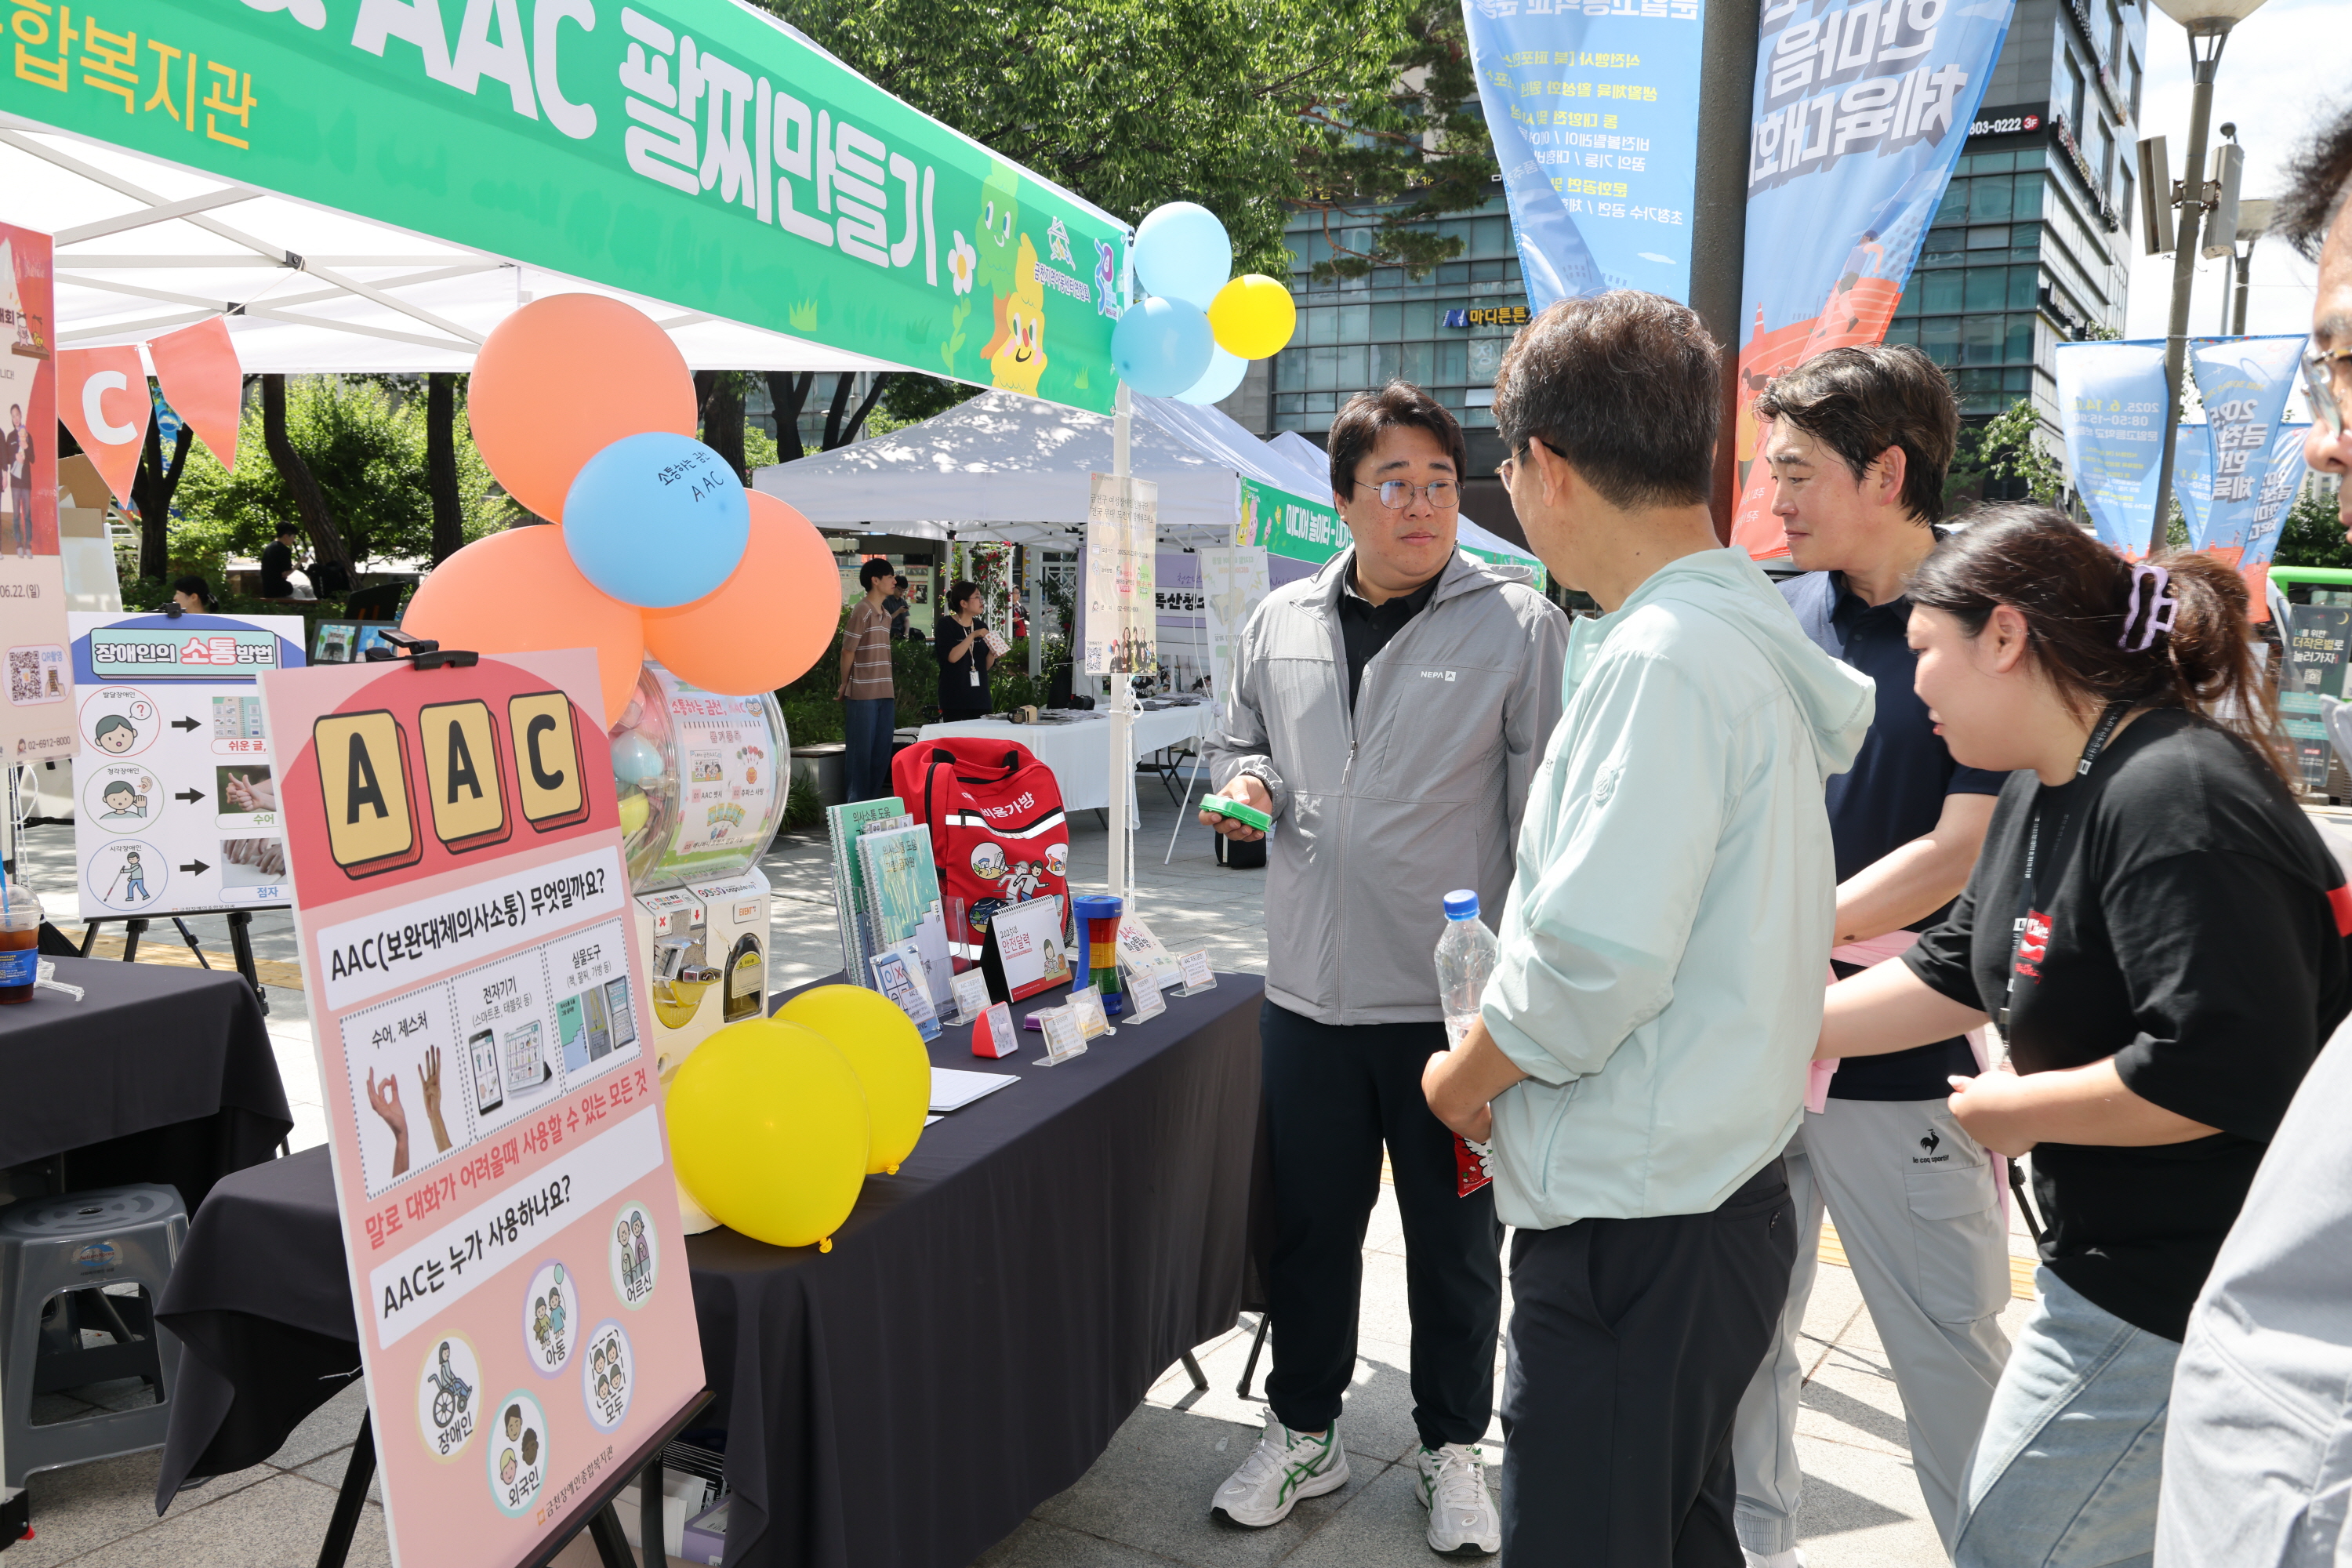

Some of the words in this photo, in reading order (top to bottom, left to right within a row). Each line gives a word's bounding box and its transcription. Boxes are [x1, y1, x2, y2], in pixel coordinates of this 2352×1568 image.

[0, 0, 257, 150] 합복지관
[2024, 118, 2038, 129] 3F
[619, 6, 938, 287] 팔찌만들기
[82, 370, 138, 445] C
[691, 470, 724, 503] AAC
[1286, 503, 1309, 540] 미디어
[1308, 511, 1331, 546] 놀이터
[2310, 629, 2325, 638] 위한
[94, 643, 177, 664] 장애인의
[2292, 637, 2344, 652] 더작은별로
[1421, 670, 1444, 680] NEPA
[671, 699, 704, 716] 소통하는
[705, 699, 728, 717] 금천,
[28, 736, 71, 750] 02-6912-8000
[228, 740, 250, 752] 쉬운
[107, 767, 140, 775] 청각장애인
[253, 813, 274, 825] 수어
[852, 809, 877, 824] 의사소통
[878, 806, 891, 819] 도움
[110, 844, 142, 852] 시각장애인
[257, 886, 278, 898] 점자
[739, 906, 753, 916] EVENT
[332, 889, 527, 982] AAC(보완대체의사소통)
[531, 867, 605, 916] 무엇일까요?
[1001, 933, 1030, 954] 안전달력
[572, 944, 601, 970] 실물도구
[592, 964, 603, 978] 가방
[483, 975, 517, 1002] 전자기기
[503, 997, 523, 1016] 태블릿
[397, 1010, 428, 1040] 제스처
[365, 1203, 403, 1250] 말로
[406, 1172, 457, 1222] 대화가
[460, 1137, 520, 1189] 어려울때
[523, 1113, 562, 1156] 사용할
[566, 1105, 580, 1131] 수
[581, 1091, 607, 1127] 있는
[608, 1080, 633, 1109] 모든
[634, 1067, 648, 1098] 것
[1913, 1155, 1919, 1163] le
[1920, 1156, 1931, 1165] coq
[1931, 1154, 1950, 1163] sportif
[384, 1258, 445, 1319] AAC는
[449, 1229, 483, 1276] 누가
[488, 1174, 572, 1250] 사용하나요?
[627, 1279, 652, 1303] 어르신
[546, 1338, 566, 1366] 아동
[605, 1398, 624, 1425] 모두
[437, 1411, 474, 1457] 장애인
[508, 1466, 540, 1508] 외국인
[546, 1444, 615, 1518] 금천장애인종합복지관
